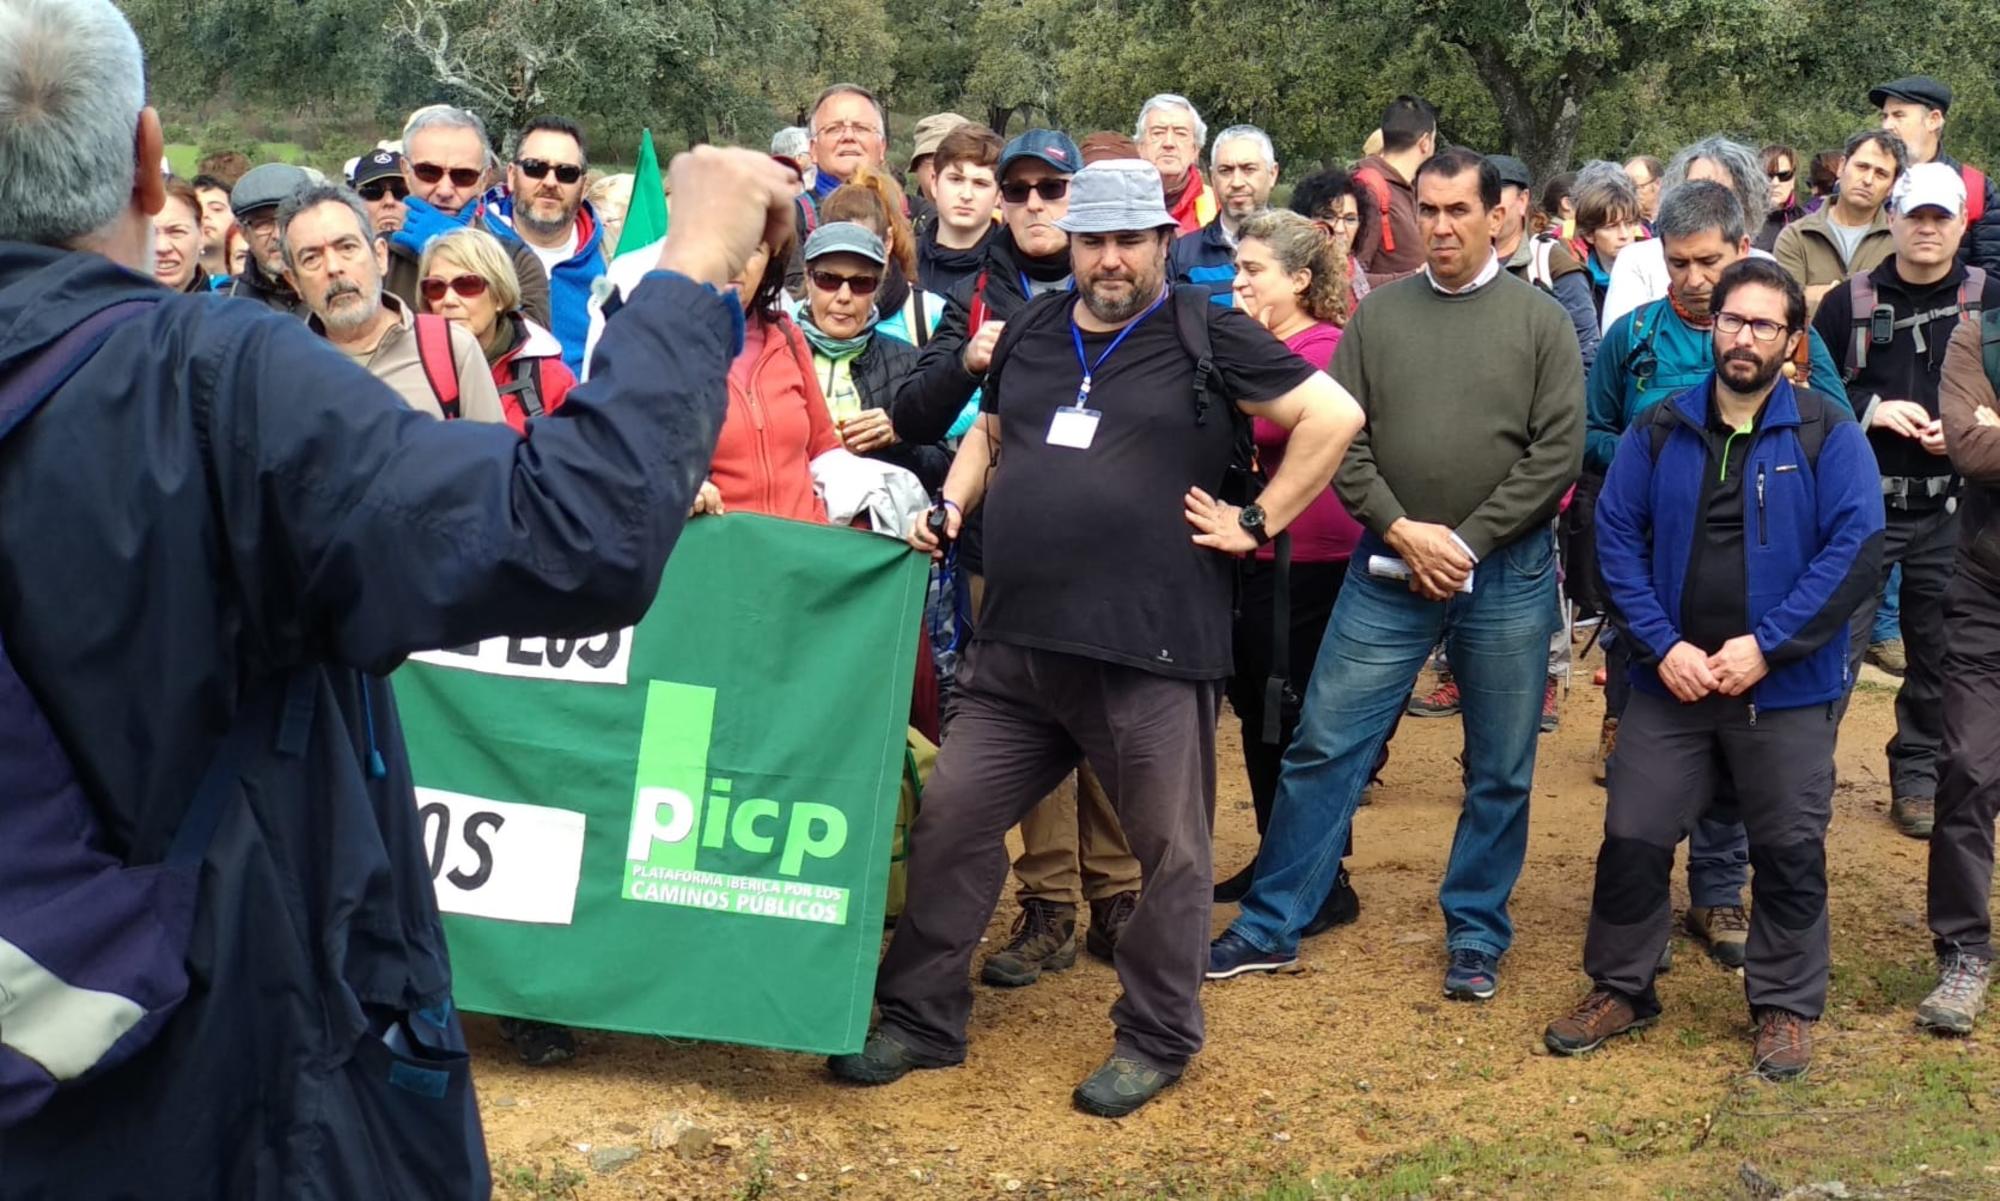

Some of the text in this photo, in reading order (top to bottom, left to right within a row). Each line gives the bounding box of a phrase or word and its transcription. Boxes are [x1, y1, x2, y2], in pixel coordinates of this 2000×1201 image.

[626, 777, 848, 877] picp
[630, 880, 837, 922] CAMINOS PÚBLICOS
[632, 864, 723, 888] PLATAFORMA
[783, 881, 812, 898] POR
[815, 885, 842, 900] LOS
